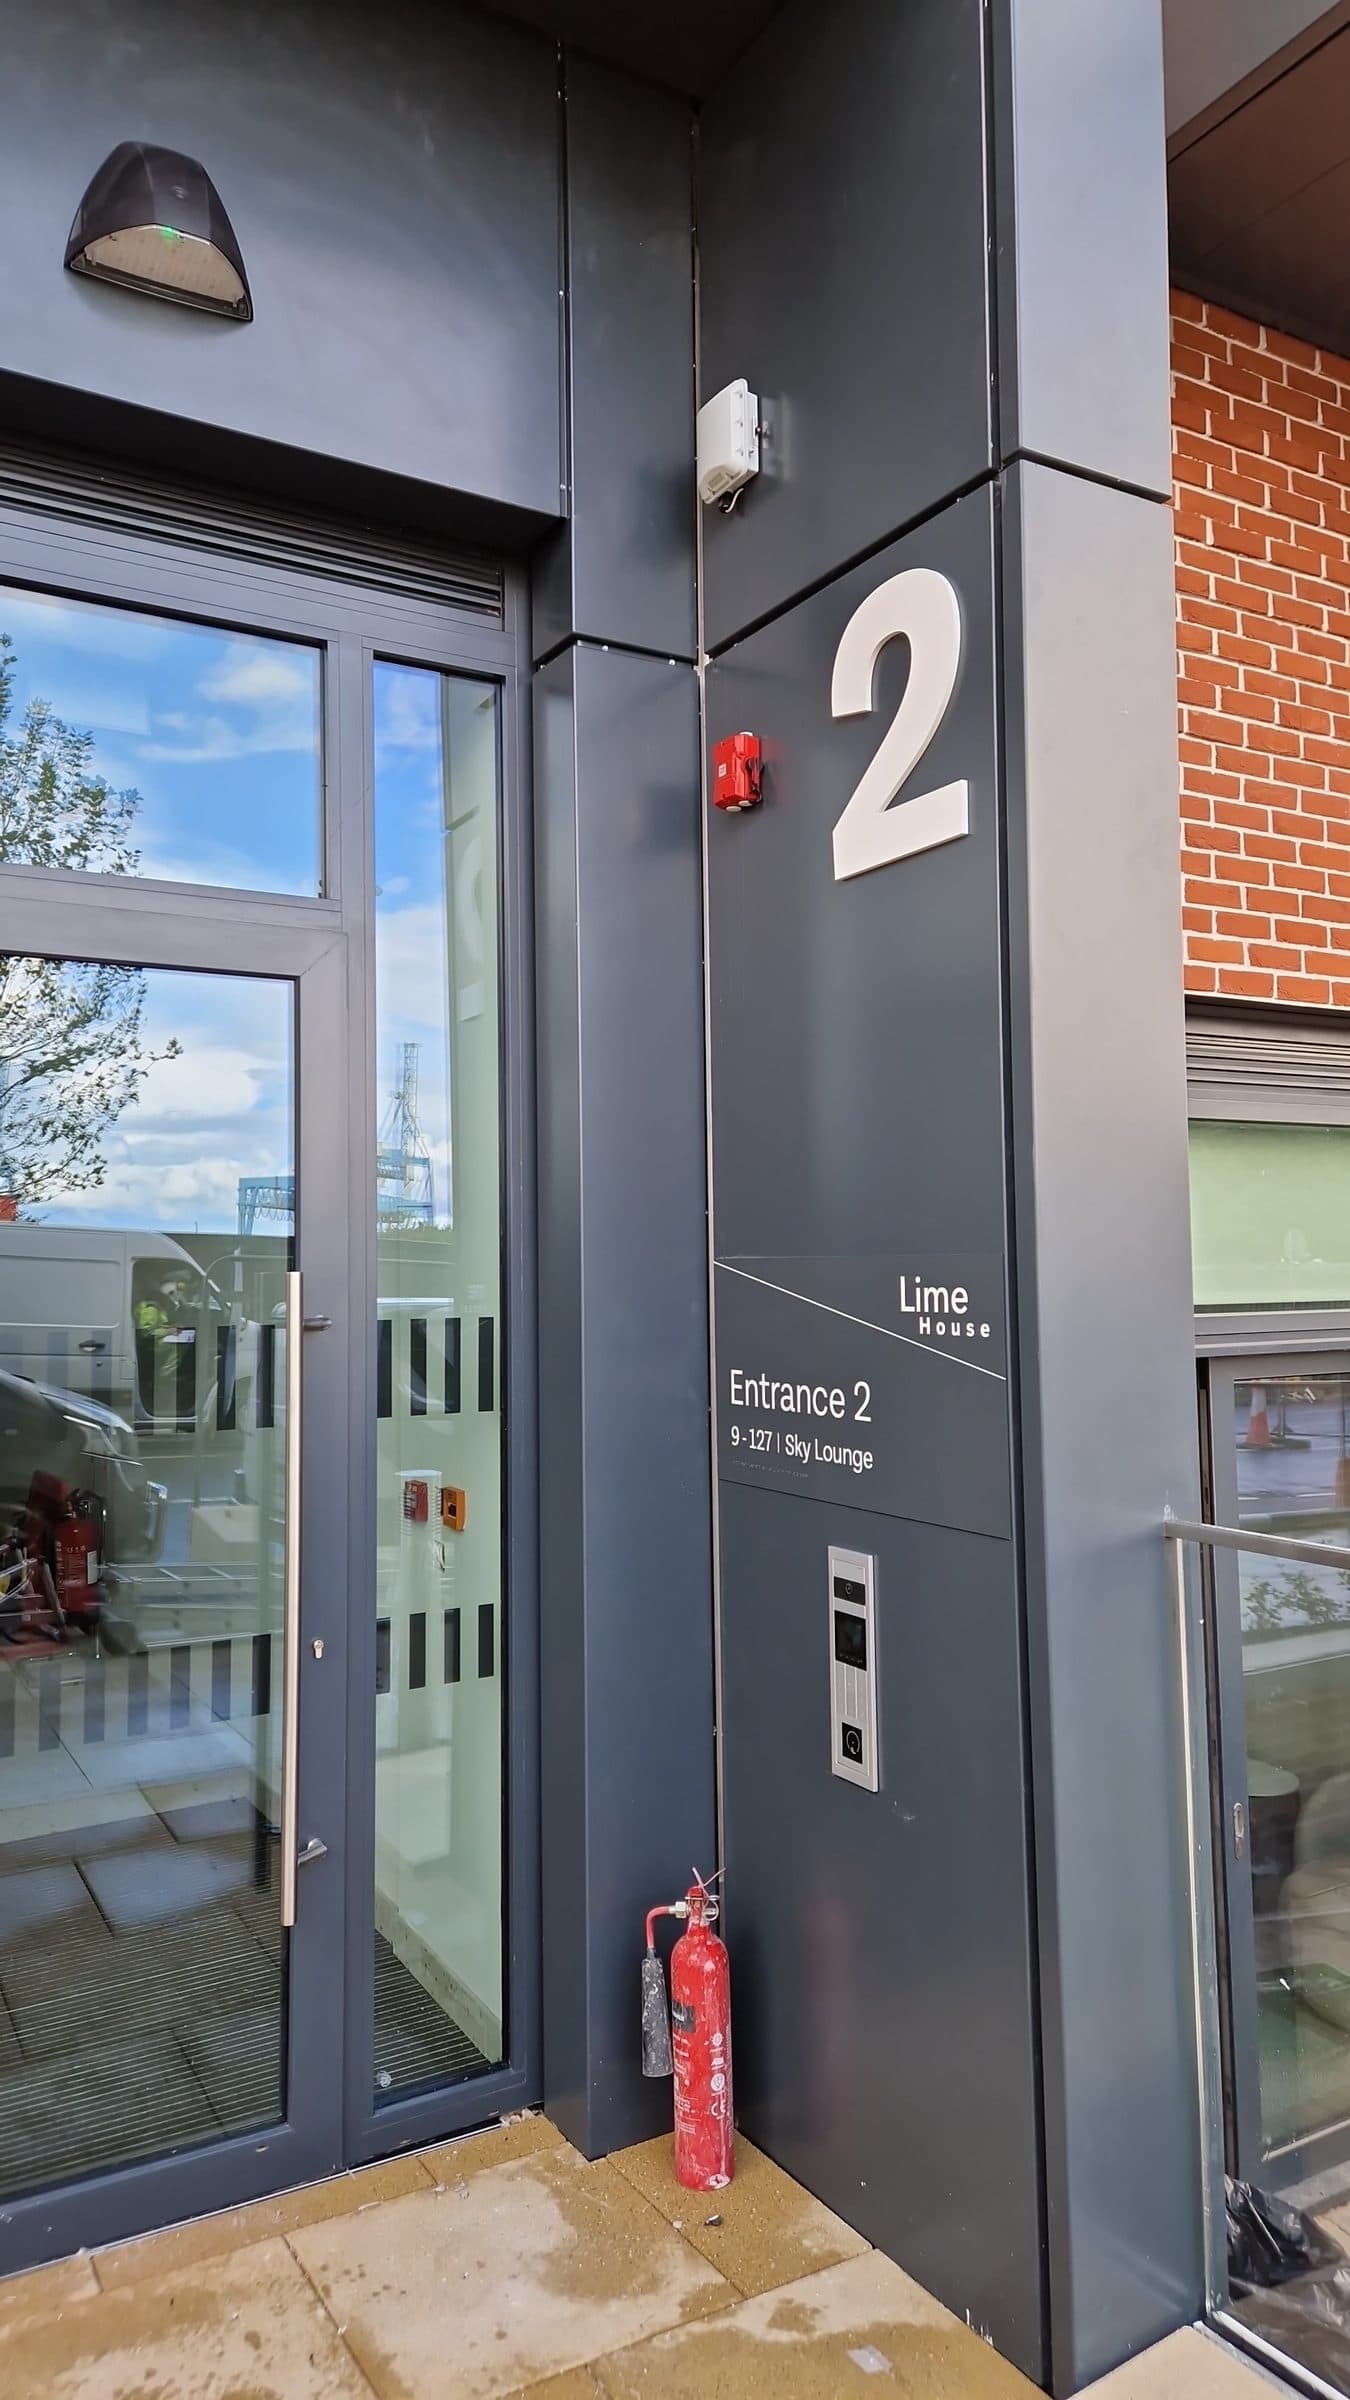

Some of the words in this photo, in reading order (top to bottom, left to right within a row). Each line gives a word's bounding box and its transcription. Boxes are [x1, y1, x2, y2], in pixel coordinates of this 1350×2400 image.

[831, 567, 969, 881] 2
[899, 1275, 969, 1315] Lime
[919, 1316, 991, 1338] House
[730, 1369, 846, 1419] Entrance
[853, 1380, 872, 1423] 2
[785, 1433, 812, 1464] Sky
[814, 1438, 874, 1474] Lounge
